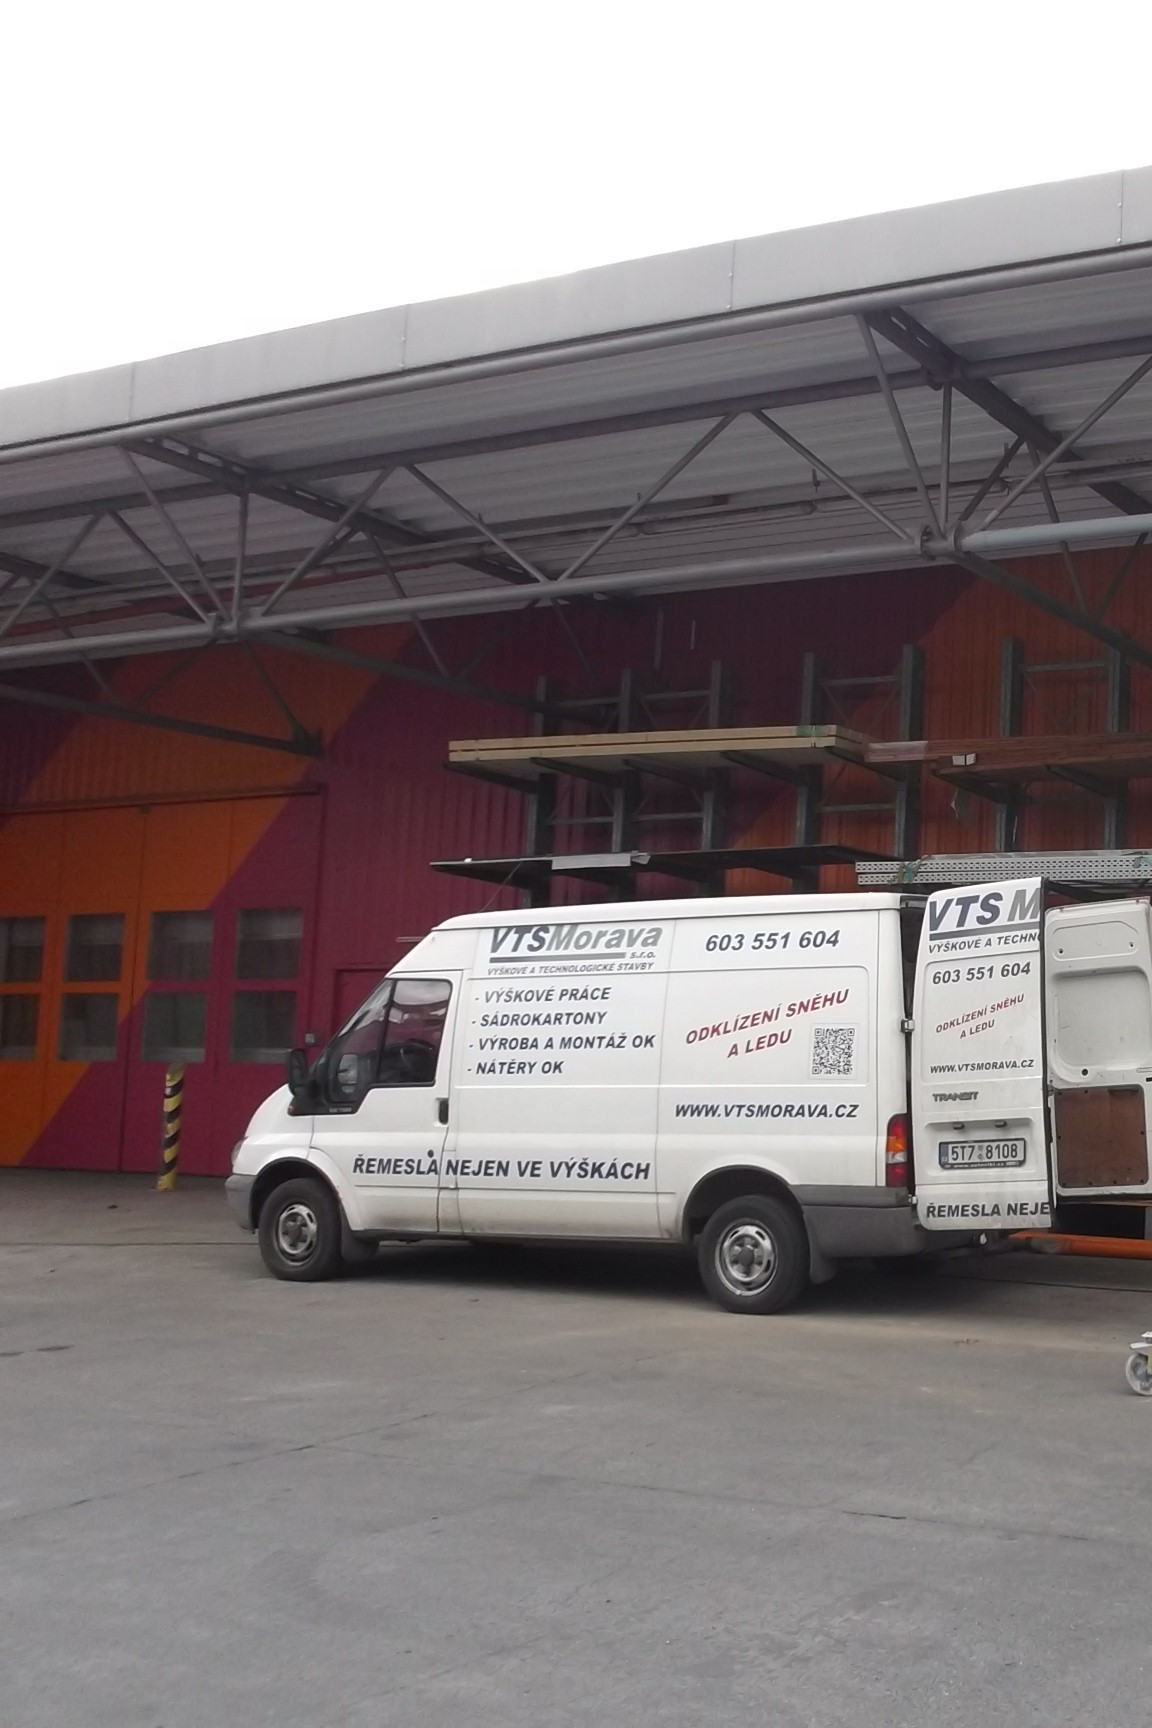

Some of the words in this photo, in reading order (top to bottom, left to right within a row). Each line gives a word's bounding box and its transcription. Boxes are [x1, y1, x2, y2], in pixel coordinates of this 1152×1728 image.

[705, 934, 745, 952] 603
[752, 932, 791, 950] 551
[798, 930, 840, 949] 604
[928, 937, 982, 954] VÝŠKOVÉ
[984, 938, 992, 948] A
[538, 962, 616, 974] TECHNOLOGICKÉ
[618, 962, 655, 972] STAVBY
[932, 969, 960, 985] 603
[966, 966, 994, 982] 551
[1000, 962, 1031, 978] 604
[484, 986, 554, 1004] VÝŠKOVÉ
[558, 985, 612, 1002] PRÁCE
[480, 1012, 608, 1027] SÁDROKARTONY
[686, 1004, 782, 1044] ODKLÍZENÍ
[786, 988, 850, 1018] SNĚHU
[936, 1007, 988, 1034] ODKLÍZENÍ
[990, 994, 1024, 1014] SNĚHU
[960, 1030, 967, 1039] A
[969, 1019, 995, 1036] LEDU
[478, 1035, 539, 1050] VÝROBA
[544, 1038, 554, 1050] A
[559, 1032, 627, 1050] MONTÁŽ
[632, 1035, 656, 1048] OK
[727, 1044, 739, 1058] A
[745, 1029, 792, 1054] LEDU
[476, 1061, 537, 1075] NÁTĚRY
[541, 1061, 564, 1074] OK
[930, 1060, 1034, 1074] WWW.VTSMORAVA.CZ
[932, 1091, 979, 1102] TRANSIT
[675, 1104, 860, 1118] WWW.VTSMORAVA.CZ
[951, 1144, 976, 1161] 5T7
[986, 1143, 1018, 1160] 8108
[352, 1154, 439, 1176] ŘEMESLA
[445, 1158, 510, 1178] NEJEN
[517, 1160, 542, 1178] VE
[550, 1156, 650, 1180] VÝŠKÁCH
[926, 1202, 1001, 1218] ŘEMESLA
[1006, 1202, 1050, 1216] NEJE
